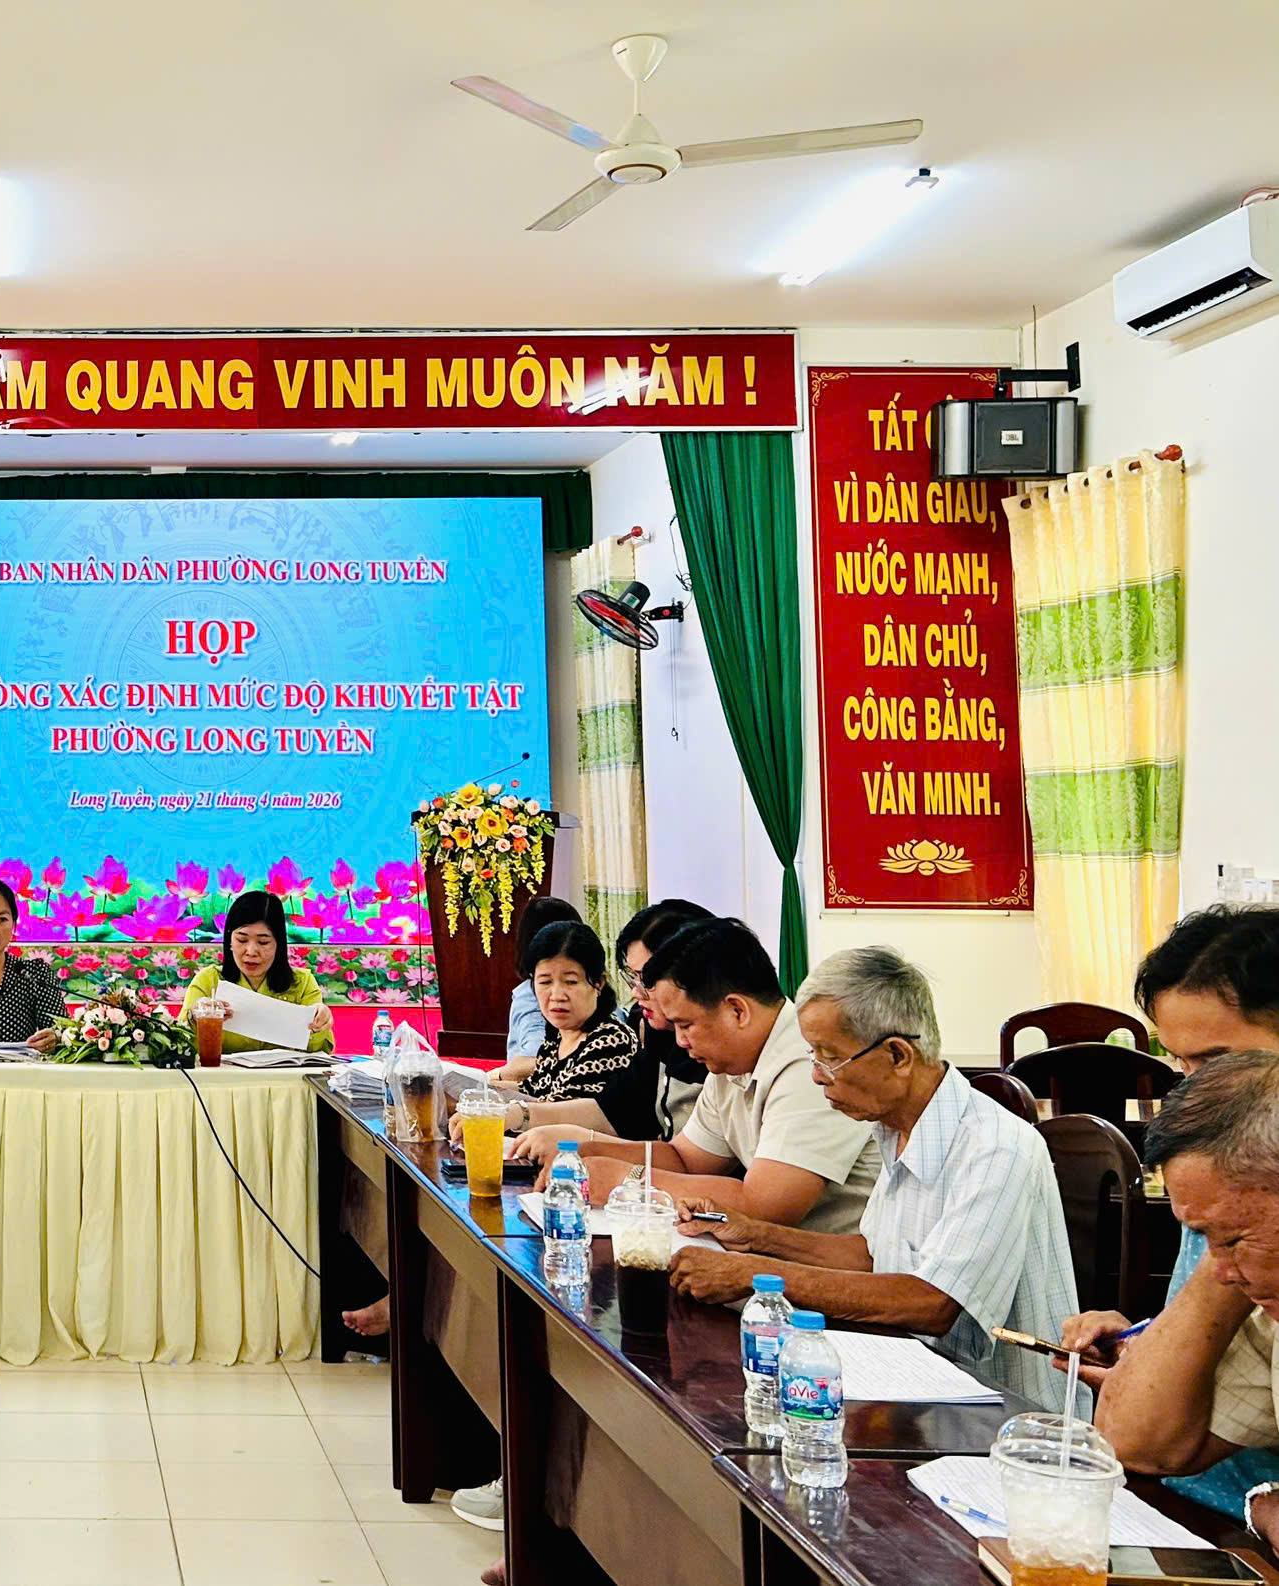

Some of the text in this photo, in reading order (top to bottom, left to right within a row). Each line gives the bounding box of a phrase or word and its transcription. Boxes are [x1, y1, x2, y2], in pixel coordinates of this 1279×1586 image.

[66, 359, 254, 415] QUANG
[273, 359, 405, 409] VINH
[427, 345, 586, 409] MUÔN
[603, 343, 725, 406] NĂM
[868, 392, 918, 451] TẤT
[834, 471, 859, 523] VÌ
[866, 472, 919, 523] DÂN
[51, 556, 115, 582] NHÂN
[121, 556, 170, 582] DÂN
[176, 554, 288, 582] PHƯỜNG
[295, 561, 361, 582] LONG
[367, 556, 446, 582] TUYỀN
[835, 538, 998, 605] NƯỚC MẠNH,
[165, 619, 256, 665] HỌP
[863, 608, 987, 676] DÂN CHỦ,
[57, 676, 118, 708] XÁC
[126, 684, 199, 714] ĐỊNH
[207, 678, 275, 708] MỨC
[283, 680, 326, 714] ĐỘ
[333, 676, 457, 708] KHUYẾT
[465, 680, 523, 715] TẬT
[843, 678, 1005, 751] CÔNG BẰNG,
[51, 720, 375, 752] PHƯỜNG LONG TUYỀN
[69, 788, 341, 809] Long Tuyền, ngày 21 tháng 4 năm 2026
[862, 760, 1001, 816] VĂN MINH.
[787, 1384, 819, 1400] aVie
